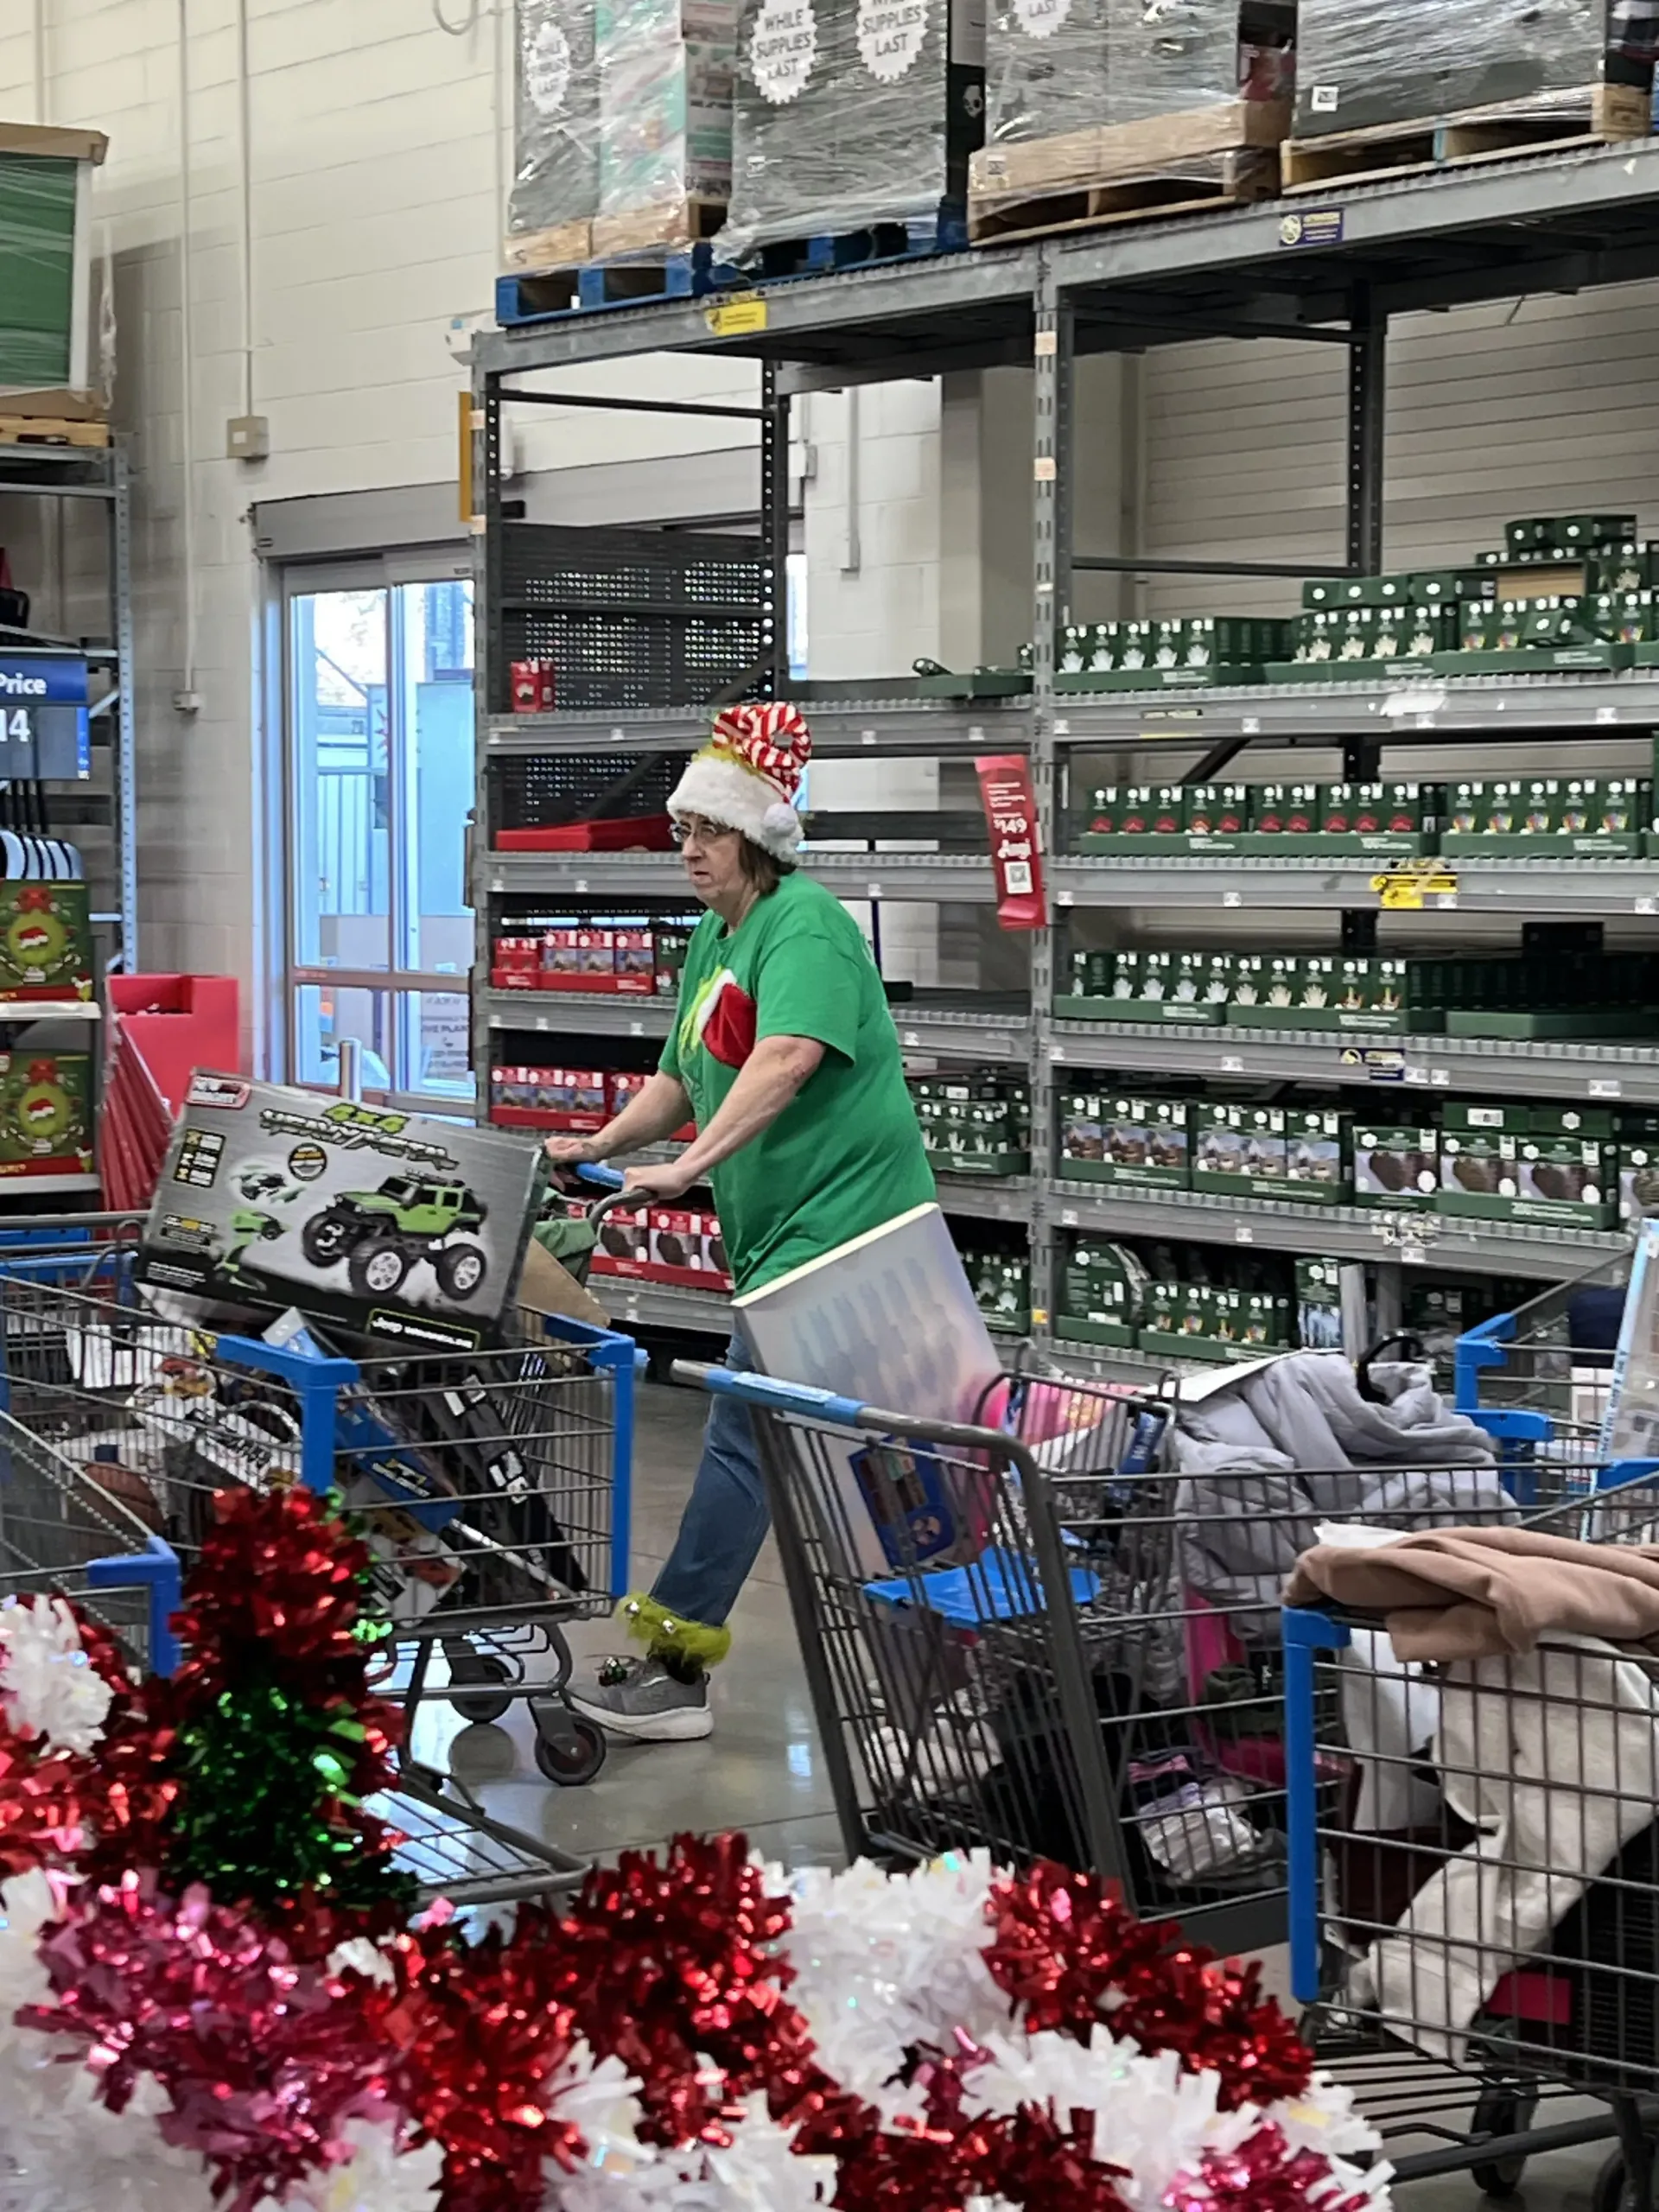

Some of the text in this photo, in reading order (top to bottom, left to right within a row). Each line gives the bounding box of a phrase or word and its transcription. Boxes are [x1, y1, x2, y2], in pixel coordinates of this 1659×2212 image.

[764, 10, 804, 31] WHILE
[862, 4, 923, 35] SUPPLIES
[756, 32, 811, 60] SUPPLIES
[874, 33, 908, 57] LAST
[767, 59, 798, 80] LAST
[0, 672, 47, 695] Price
